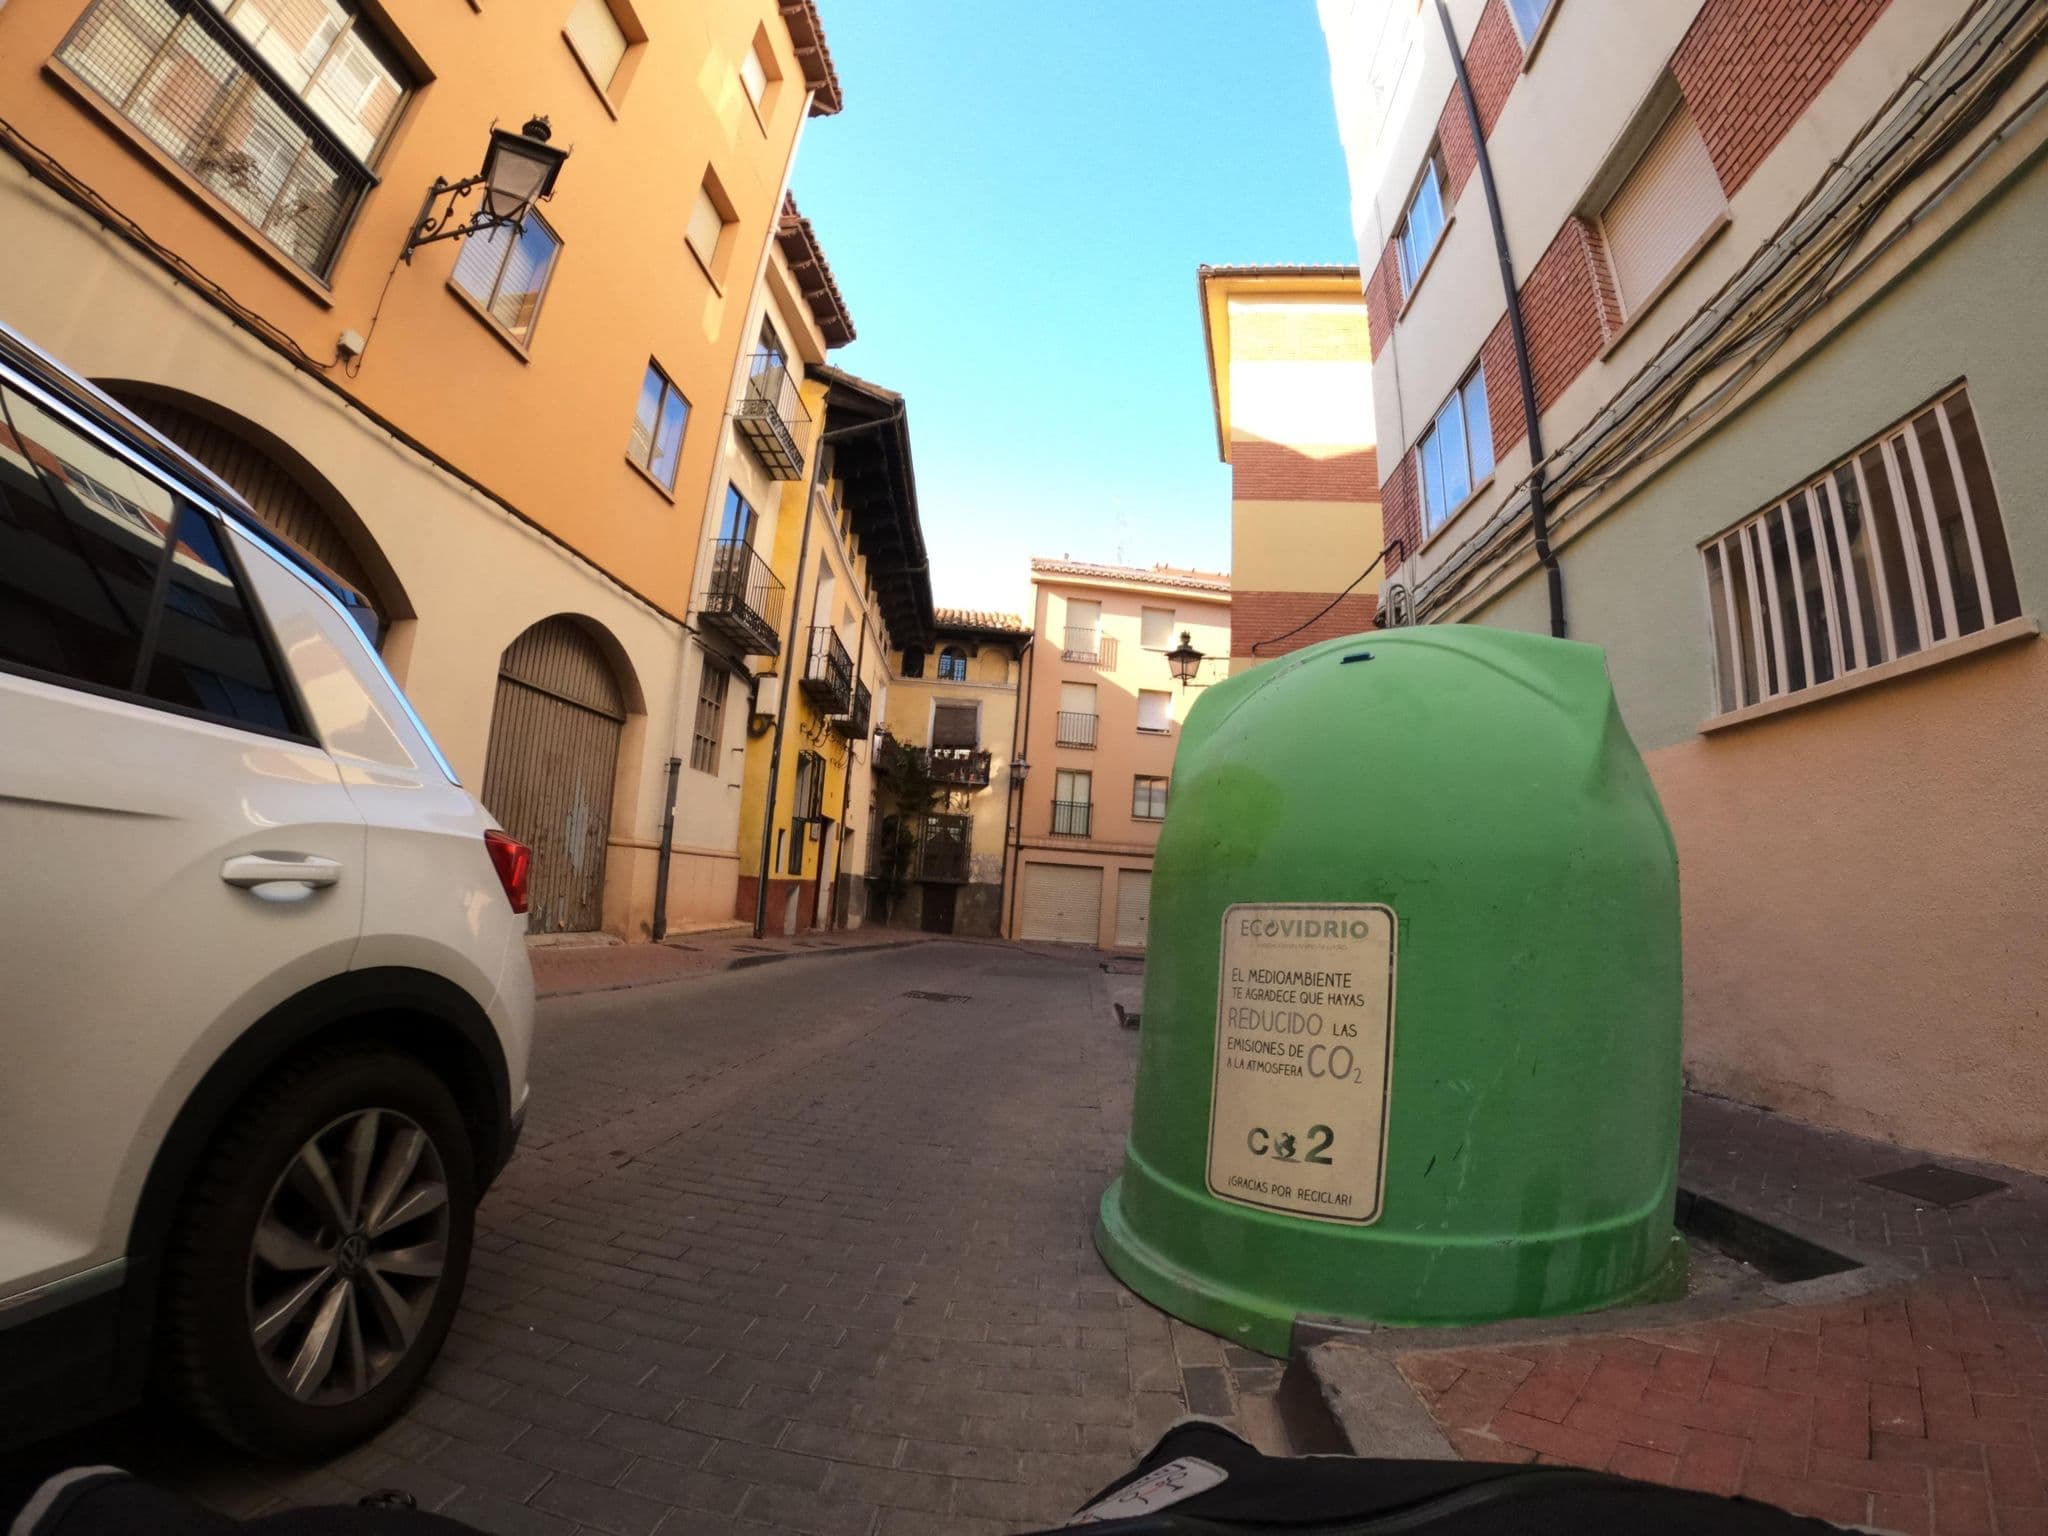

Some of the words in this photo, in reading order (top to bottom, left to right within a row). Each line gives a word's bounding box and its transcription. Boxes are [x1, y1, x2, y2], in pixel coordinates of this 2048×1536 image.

[1240, 919, 1369, 939] ECOVIDRIO
[1232, 968, 1244, 982] EL
[1249, 969, 1352, 988] MEDIOAMBIENTE
[1232, 986, 1243, 1000] TE
[1245, 988, 1297, 1004] AGRADECE
[1300, 991, 1323, 1005] QUE
[1328, 993, 1365, 1007] HAYAS
[1228, 1007, 1323, 1036] REDUCIDO
[1332, 1023, 1358, 1037] LAS
[1227, 1037, 1285, 1056] EMISIONES
[1288, 1044, 1304, 1058] DE
[1226, 1057, 1232, 1067] A
[1234, 1058, 1245, 1070] LA
[1247, 1060, 1303, 1077] ATMOSFERA
[1271, 1184, 1292, 1199] POR
